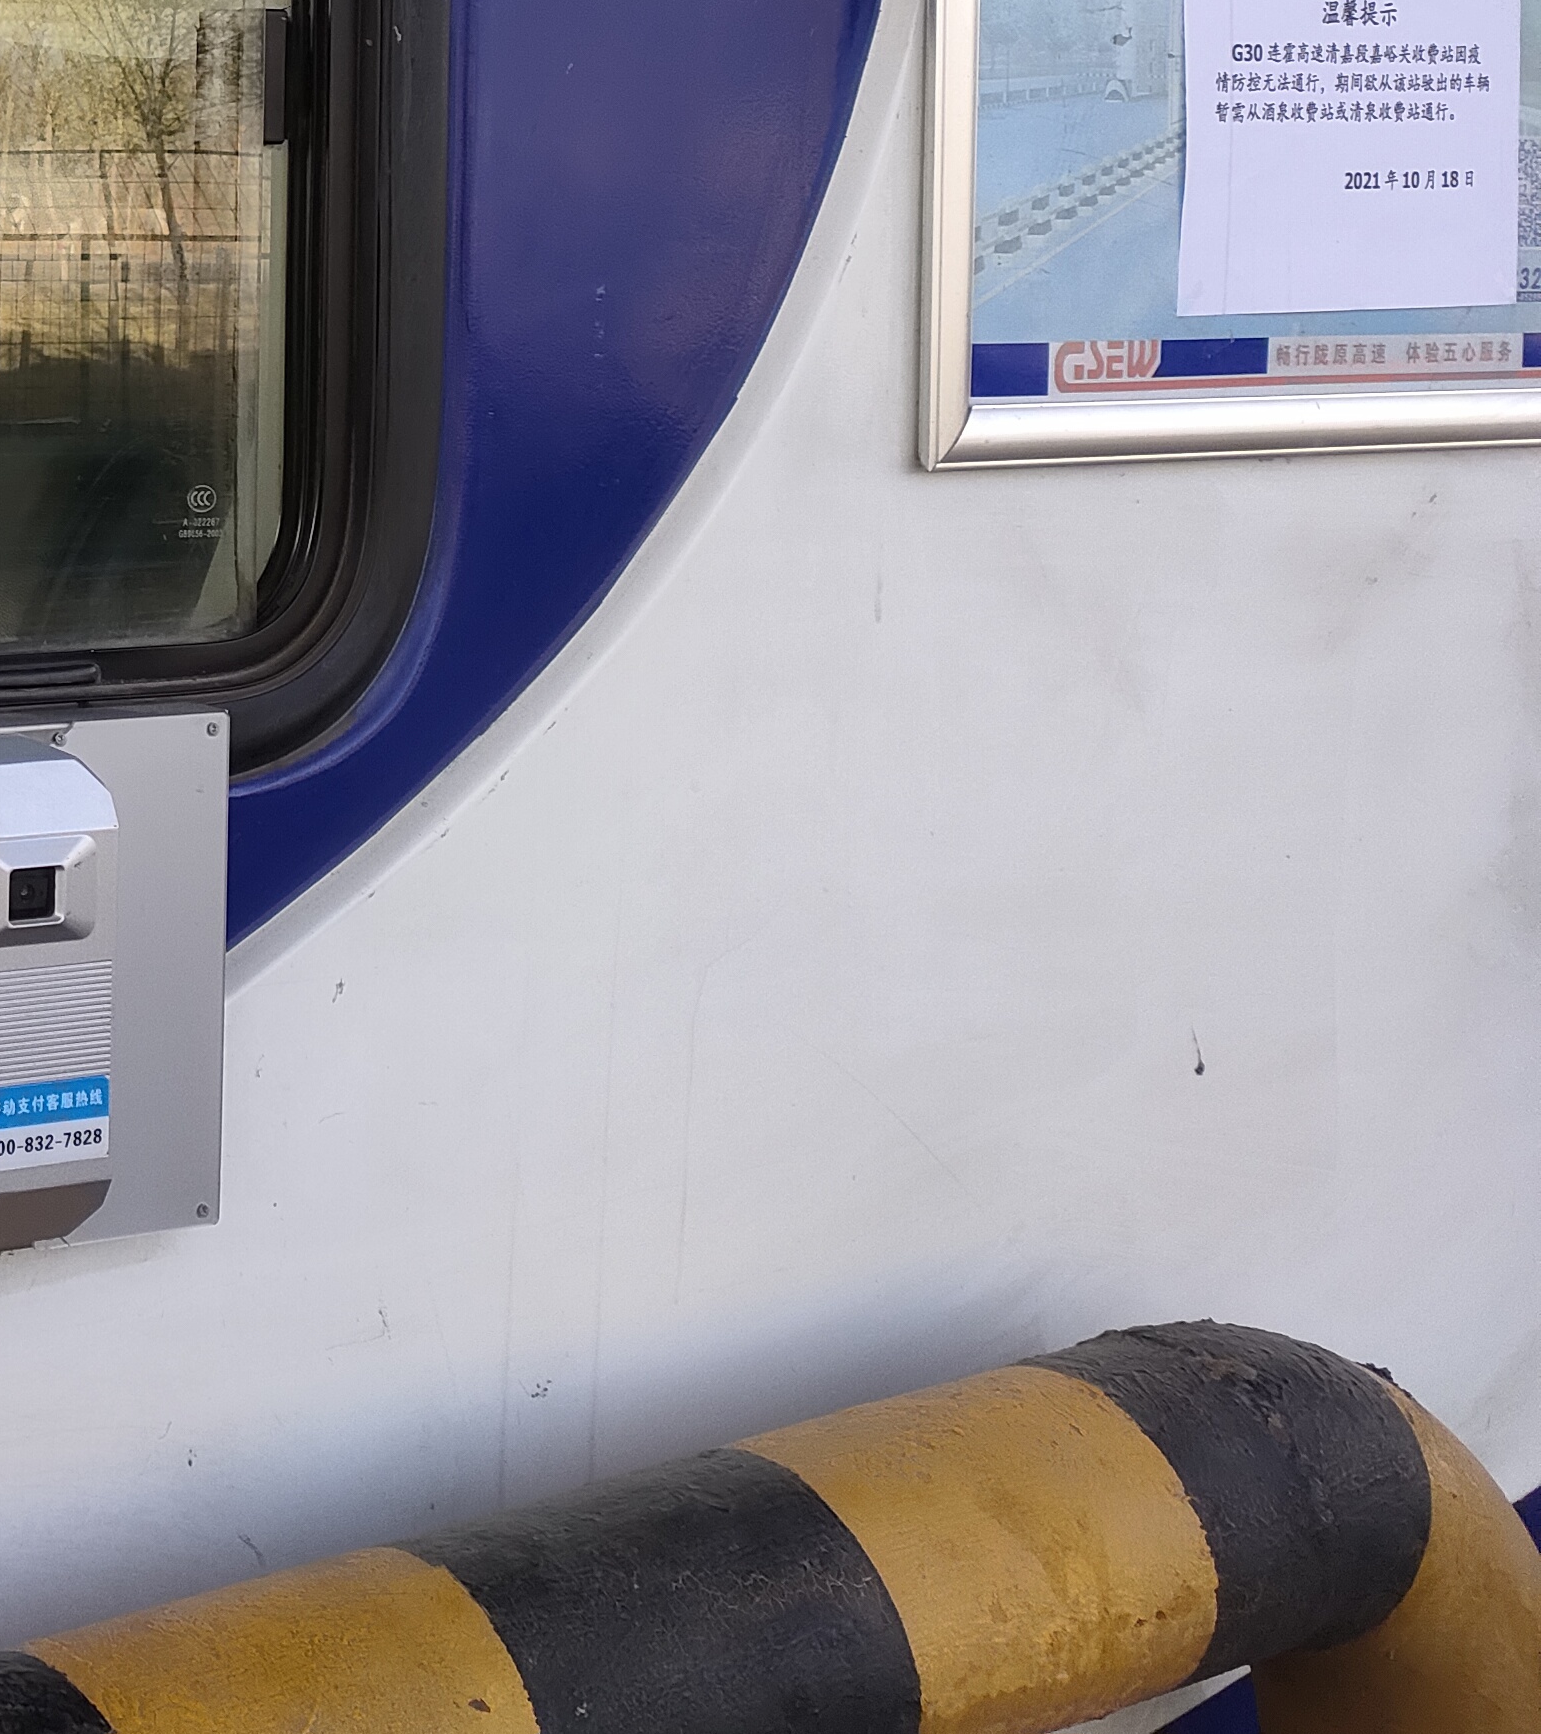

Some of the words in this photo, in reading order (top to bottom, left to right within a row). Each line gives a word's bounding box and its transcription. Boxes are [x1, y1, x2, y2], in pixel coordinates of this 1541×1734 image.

[1275, 341, 1388, 367] 畅行陇原高速
[1405, 339, 1514, 364] 体验五心服务
